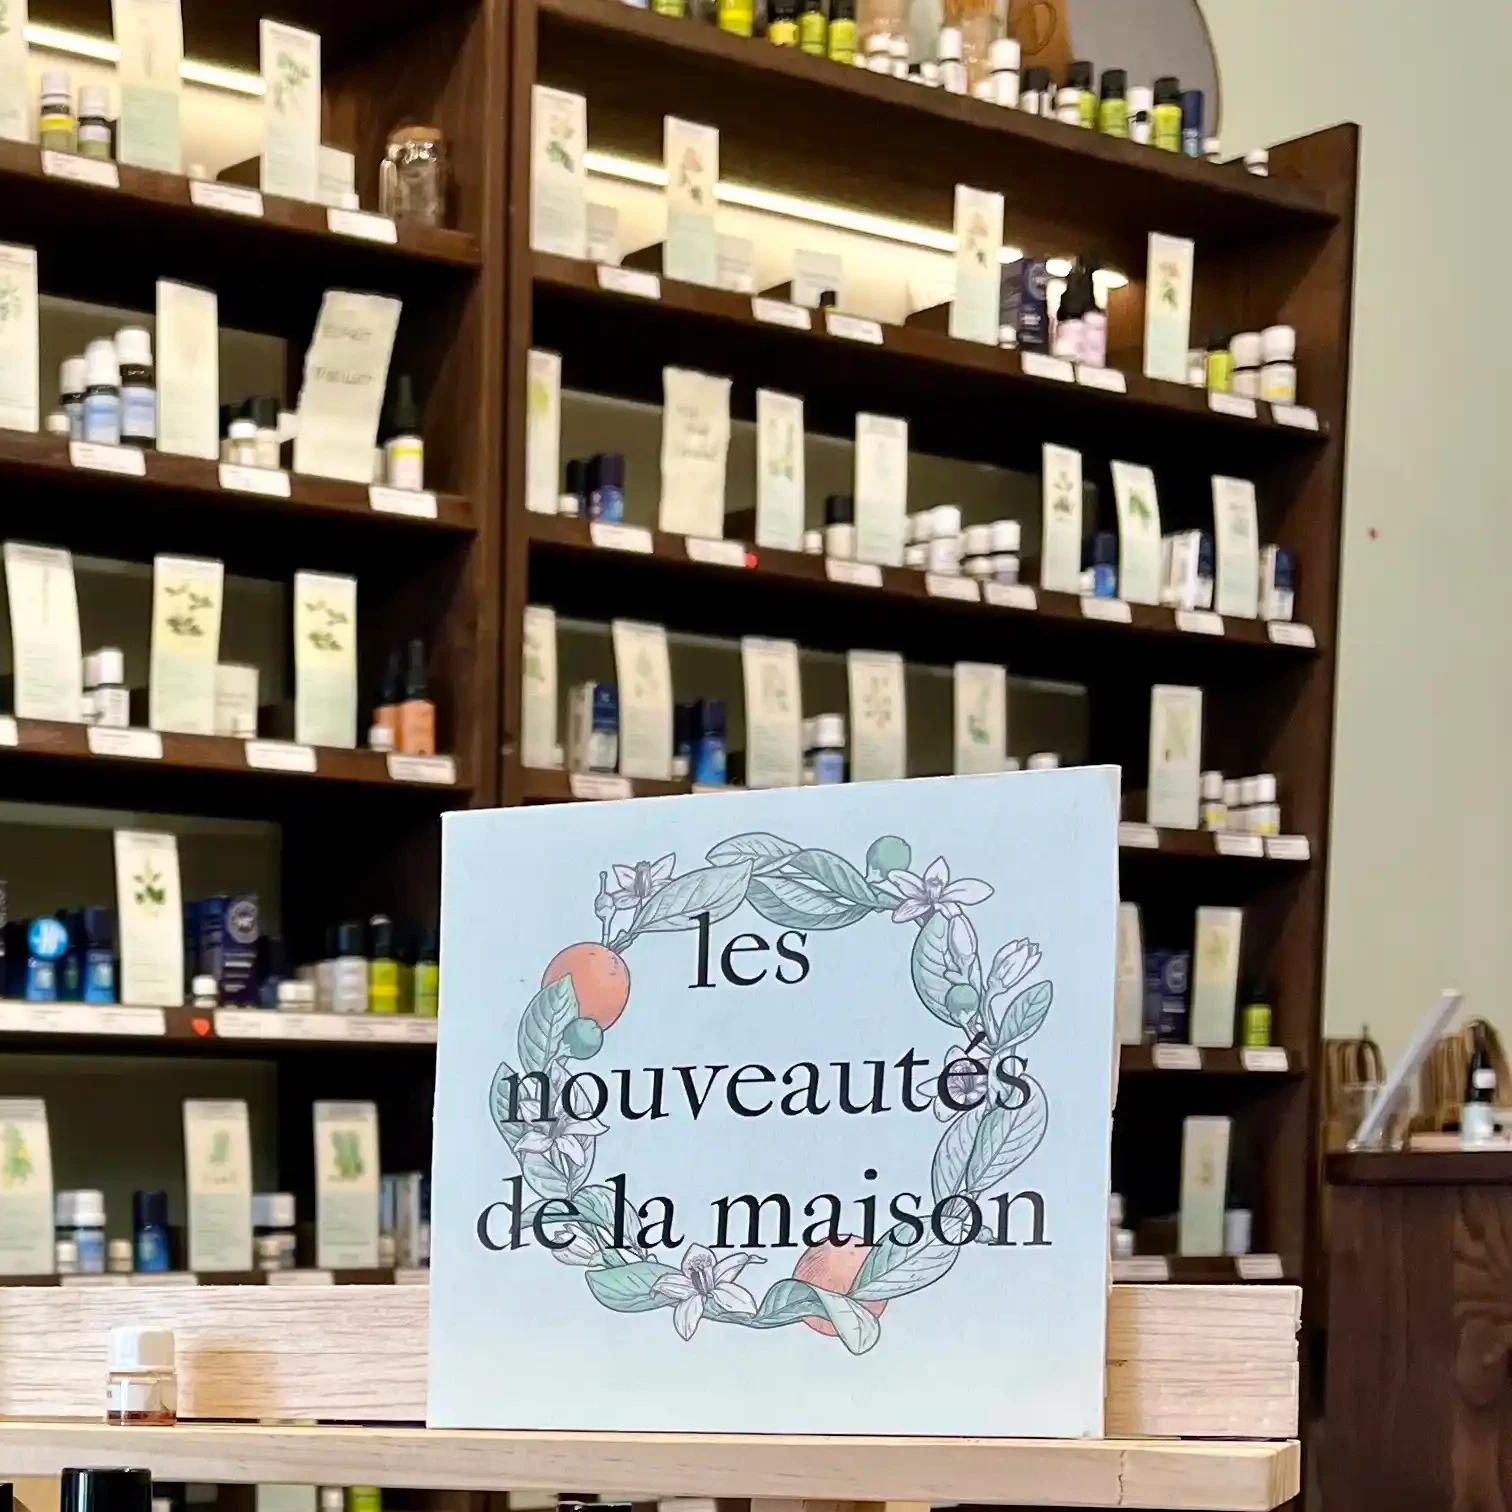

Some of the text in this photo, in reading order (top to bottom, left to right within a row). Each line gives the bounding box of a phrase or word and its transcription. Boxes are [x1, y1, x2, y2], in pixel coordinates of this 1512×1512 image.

[688, 912, 811, 990] les
[499, 1031, 1033, 1124] nouveautés
[476, 1168, 1053, 1251] de la maison
